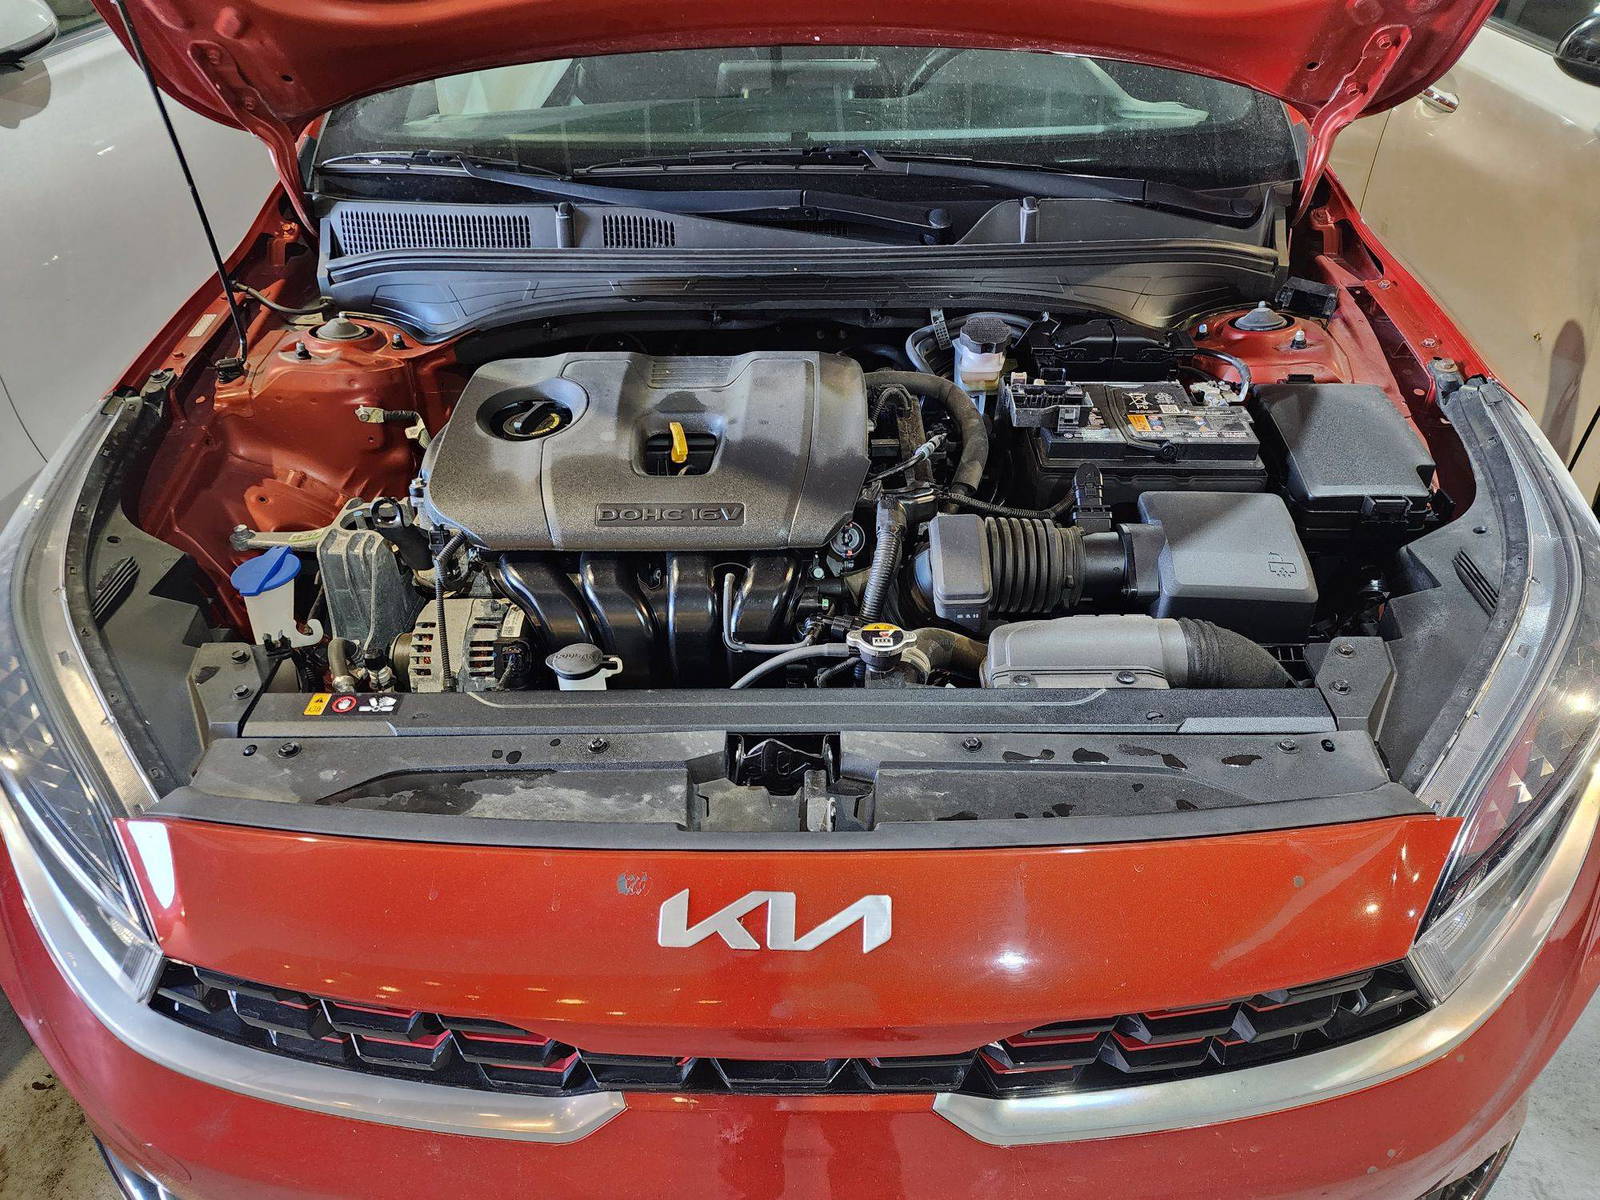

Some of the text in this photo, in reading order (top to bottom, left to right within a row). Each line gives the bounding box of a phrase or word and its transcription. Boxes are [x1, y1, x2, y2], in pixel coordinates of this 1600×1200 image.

[599, 507, 743, 521] DOHC 16V
[657, 888, 893, 954] KIA
